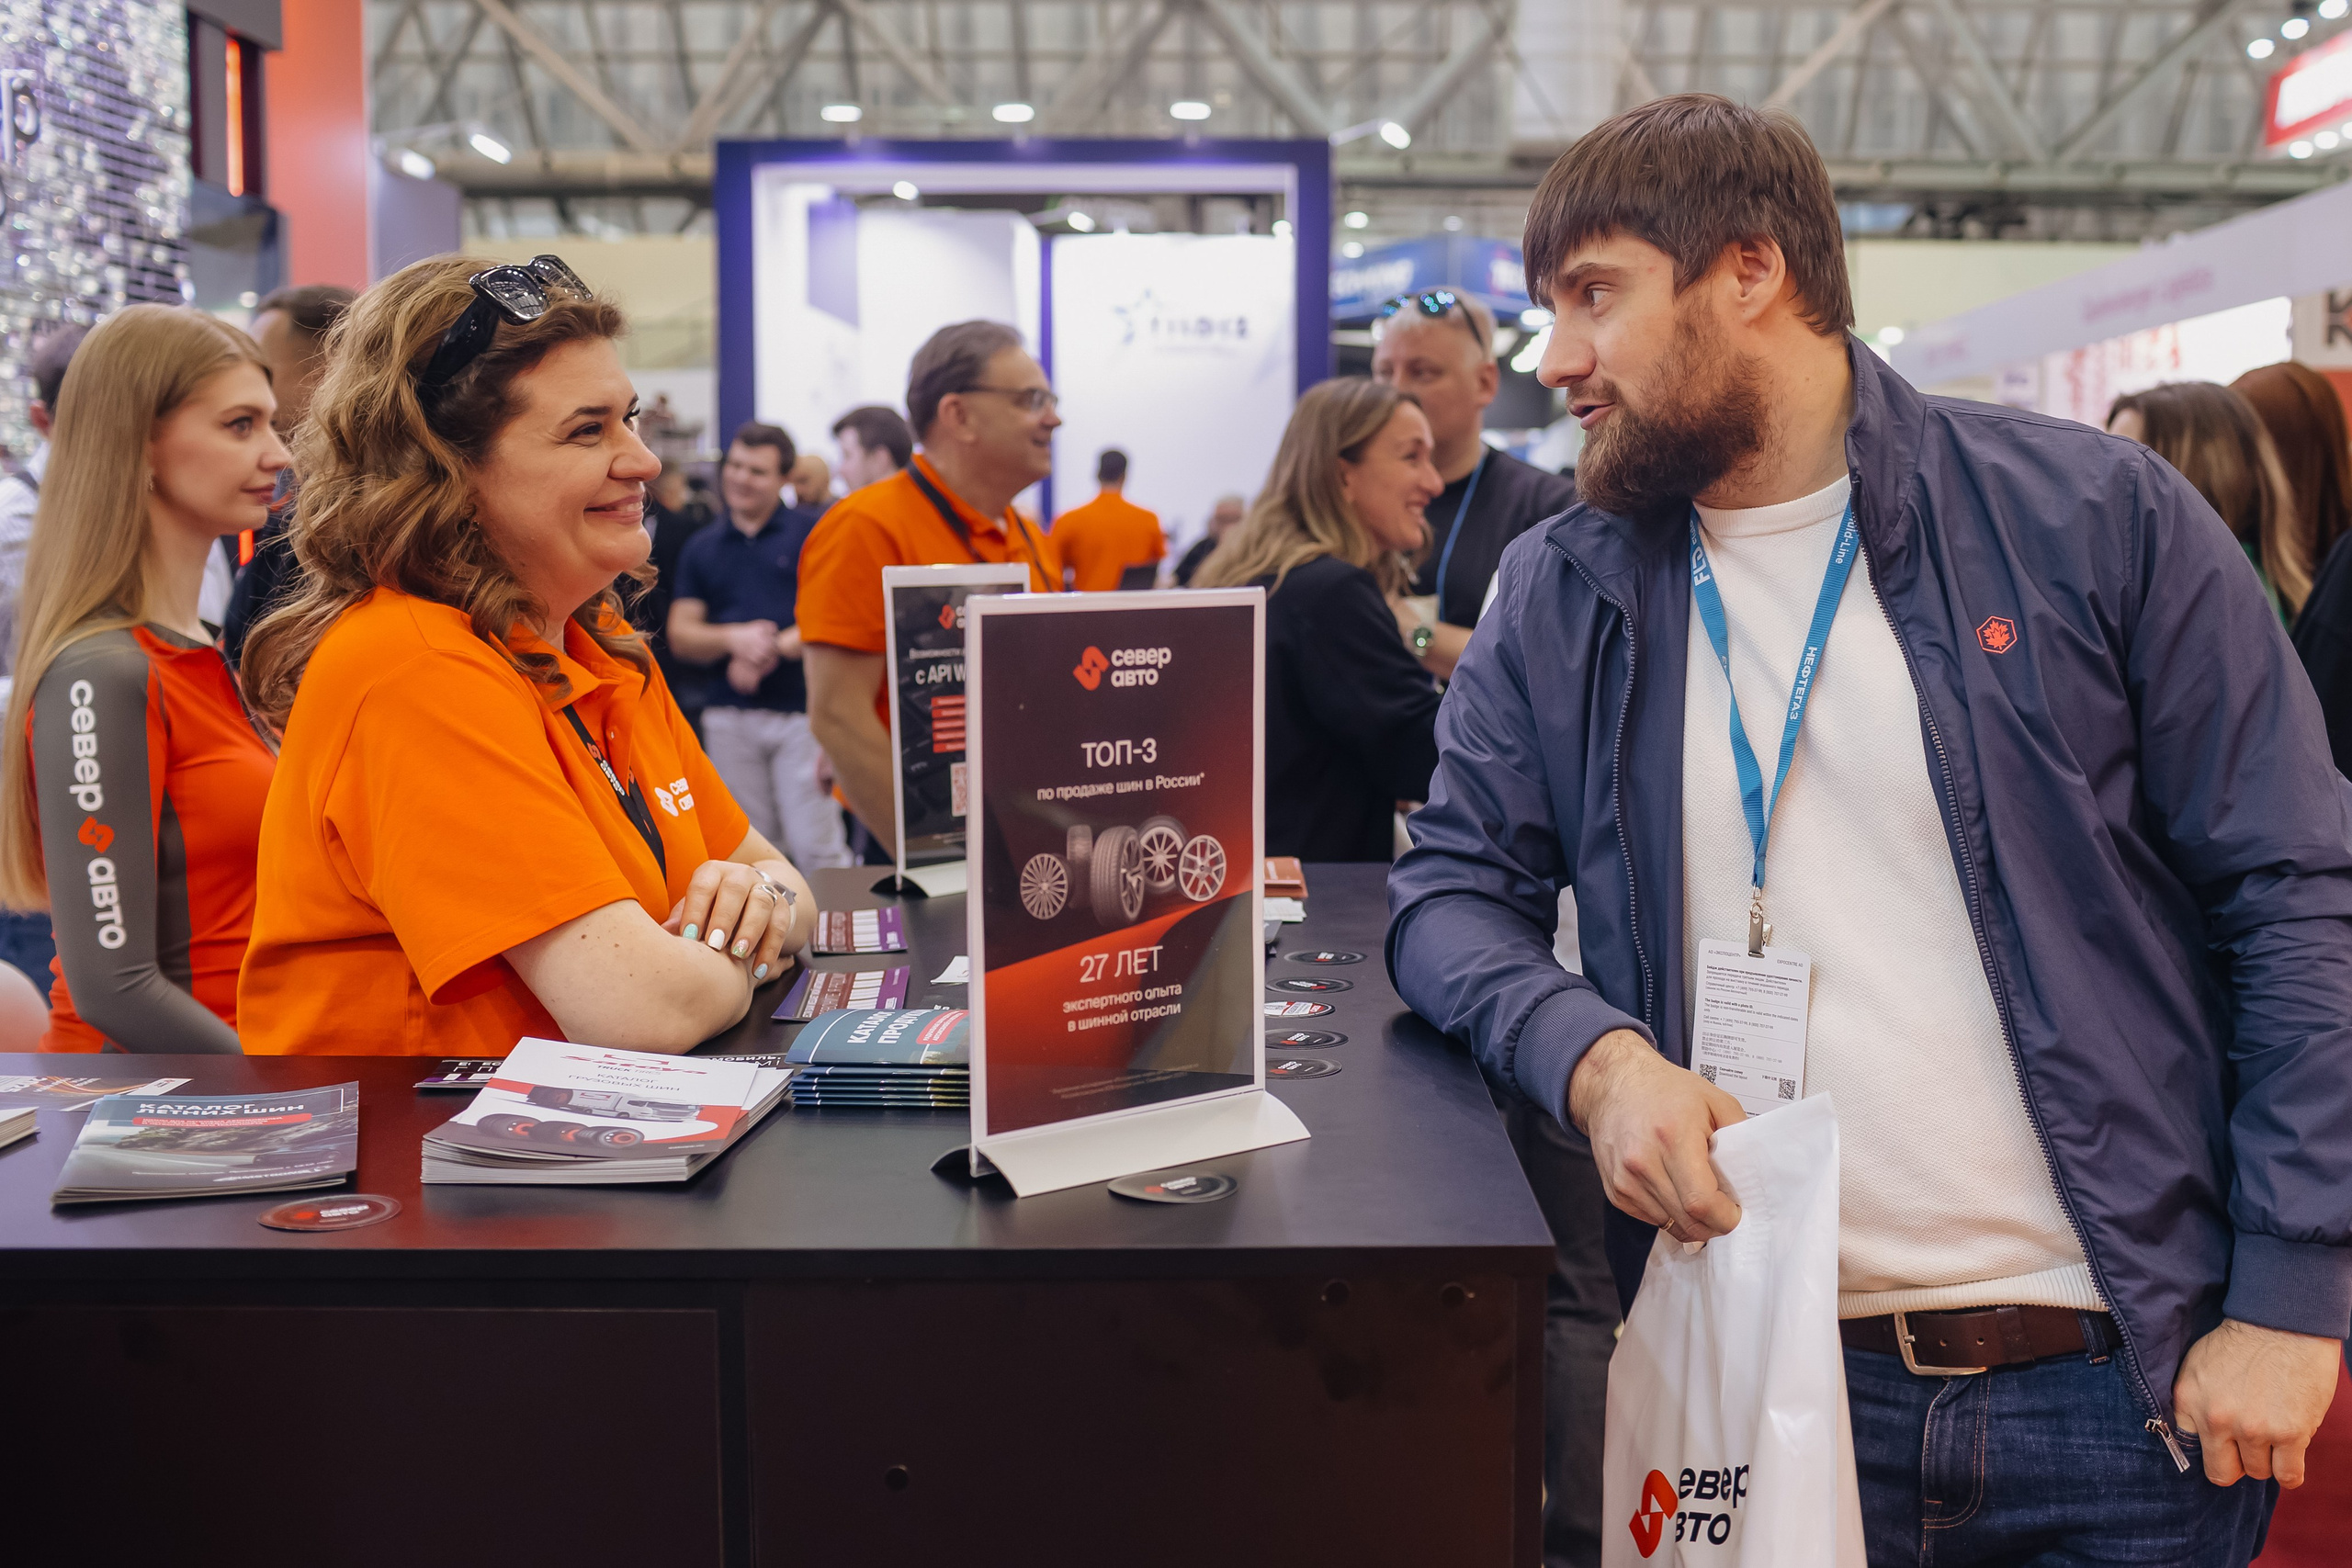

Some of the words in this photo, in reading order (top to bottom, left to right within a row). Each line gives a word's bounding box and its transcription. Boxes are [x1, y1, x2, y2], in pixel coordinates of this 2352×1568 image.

[1835, 518, 1855, 564] uid-Line
[927, 663, 953, 684] API
[1110, 646, 1171, 670] север
[1110, 667, 1159, 688] авто
[1789, 645, 1818, 721] НЕФТЕГАЗ
[68, 679, 105, 813] север
[1080, 737, 1158, 769] ТОП-3
[1036, 787, 1055, 801] по
[1056, 782, 1114, 801] продаже
[1115, 780, 1144, 794] шин
[1145, 778, 1154, 791] в
[86, 856, 127, 950] авто
[1080, 953, 1110, 984] 27
[1114, 945, 1164, 978] ЛЕТ
[1062, 988, 1143, 1015] экспертного
[1144, 982, 1183, 1001] опыта
[1067, 1021, 1076, 1033] в
[1077, 1008, 1129, 1031] шинной
[1130, 1003, 1182, 1024] отрасли
[568, 1075, 641, 1088] ГРУЗОВЫХ
[597, 1073, 658, 1083] КАТАЛОГ
[243, 1104, 304, 1114] ШИН
[1678, 1463, 1750, 1508] евер
[1675, 1511, 1732, 1545] вто
